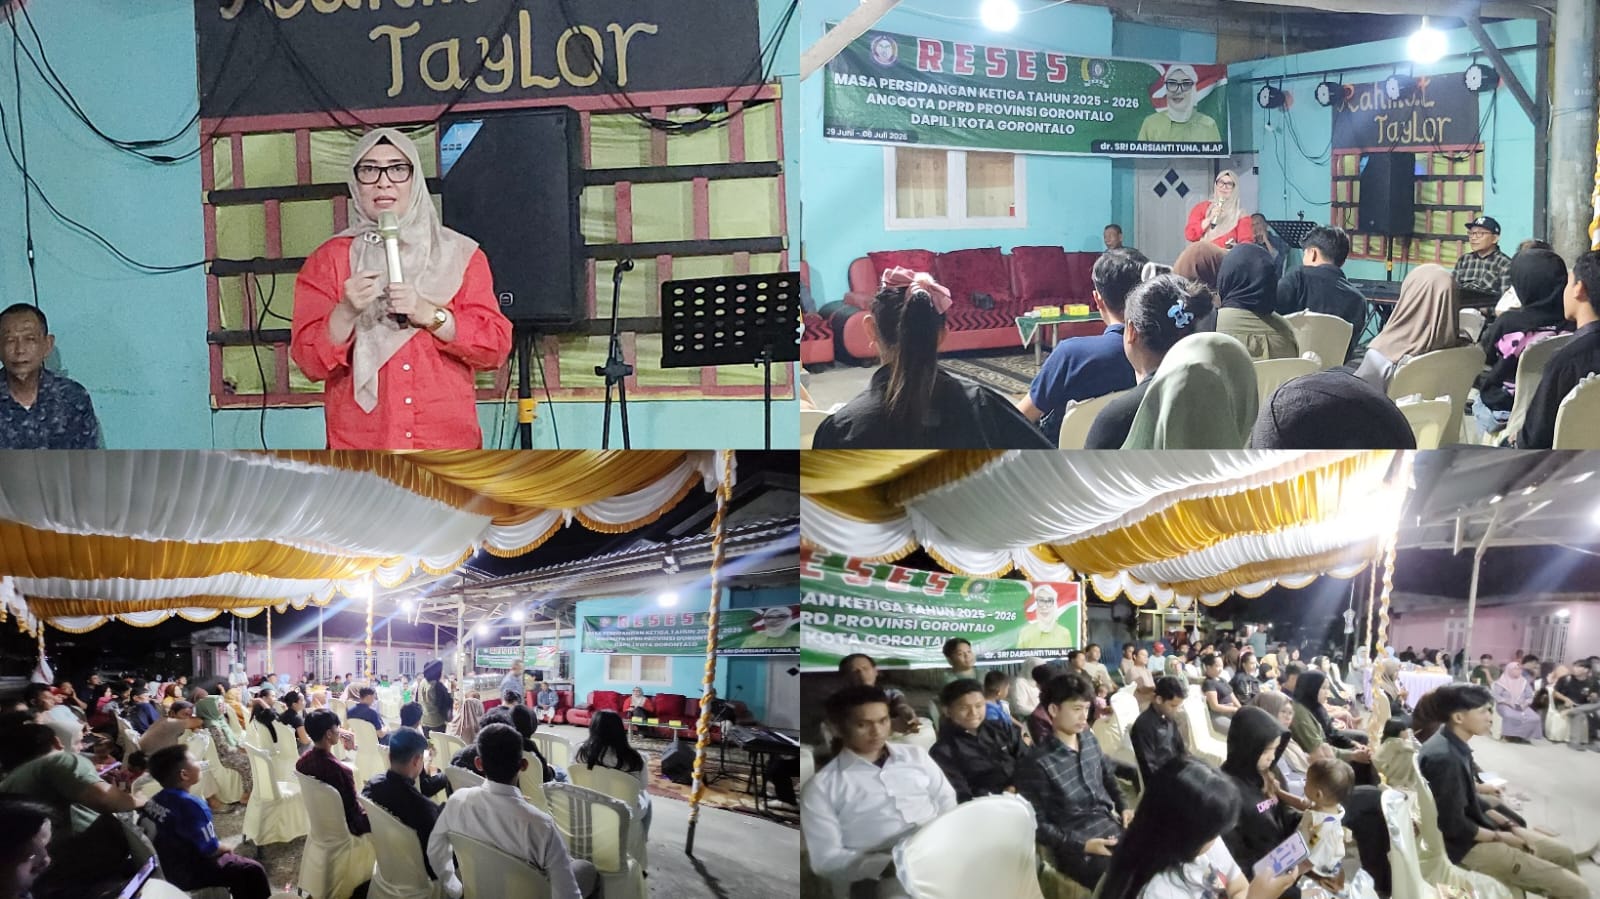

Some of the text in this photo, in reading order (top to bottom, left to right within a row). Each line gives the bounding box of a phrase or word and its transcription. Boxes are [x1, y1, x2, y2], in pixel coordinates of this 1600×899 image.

[917, 37, 1069, 84] RESES
[834, 72, 878, 88] MASA
[880, 77, 977, 98] PERSIDANGAN
[979, 86, 1028, 101] KETIGA
[1028, 91, 1072, 105] TAHUN
[1074, 94, 1101, 107] 2025
[1112, 96, 1140, 109] 2026
[866, 92, 1114, 122] ANGGOTA DPRD PROVINSI GORONTALO
[837, 128, 855, 137] Juni
[874, 131, 888, 140] Juli
[911, 113, 950, 128] DAPIL
[958, 117, 995, 131] KOTA
[997, 119, 1076, 135] GORONTALO
[1100, 142, 1224, 153] dr. SRI DARSIANTI TUNA, M.AP
[839, 595, 904, 612] KETIGA
[905, 602, 957, 618] TAHUN
[994, 611, 1017, 621] 2026
[833, 613, 918, 630] PROVINSI
[920, 619, 996, 633] GORONTALO
[804, 631, 860, 645] KOTA
